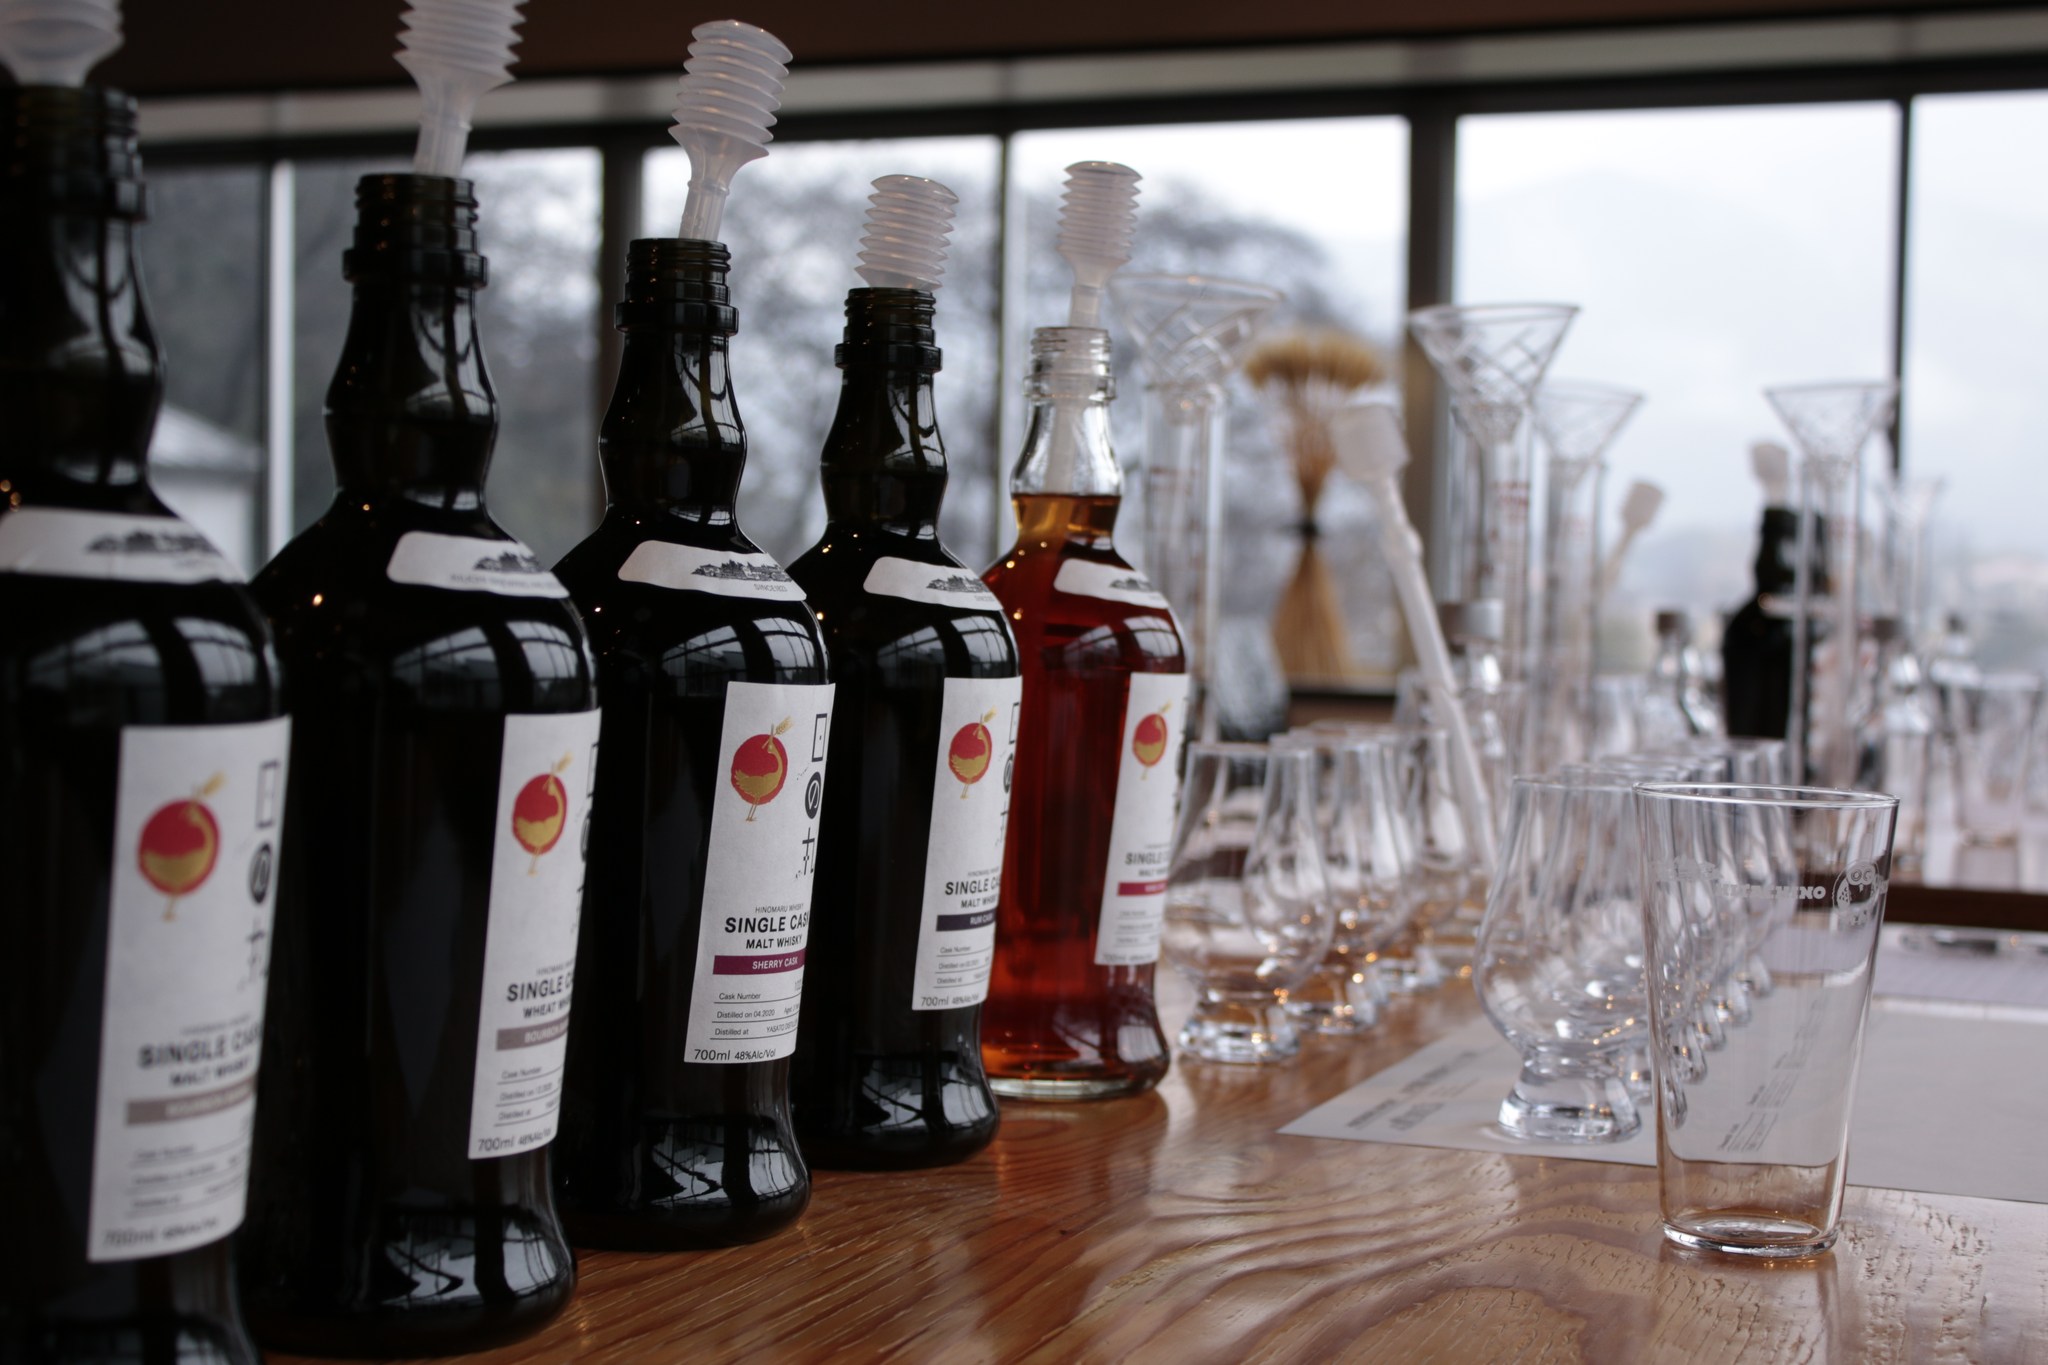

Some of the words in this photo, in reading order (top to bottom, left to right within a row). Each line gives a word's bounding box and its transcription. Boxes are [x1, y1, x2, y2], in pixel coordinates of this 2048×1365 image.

[945, 878, 989, 896] SINGLE
[755, 905, 788, 914] HINOMARU
[961, 898, 980, 909] MALT
[725, 916, 786, 934] SINGLE
[746, 938, 774, 949] MALT
[777, 934, 803, 948] WHISKY
[752, 959, 783, 970] SHERRY
[784, 956, 798, 967] CASK
[507, 975, 564, 1002] SINGLE
[719, 992, 736, 1000] Cask
[737, 992, 761, 1000] Number
[921, 996, 949, 1007] 700ml
[523, 1001, 557, 1019] WHEAT
[716, 1010, 743, 1019] Distilled
[714, 1027, 741, 1036] Distilled
[742, 1028, 750, 1036] at
[694, 1048, 731, 1061] 700ml
[734, 1048, 776, 1060] 48%Alc/Vol
[478, 1136, 514, 1152] 700ml
